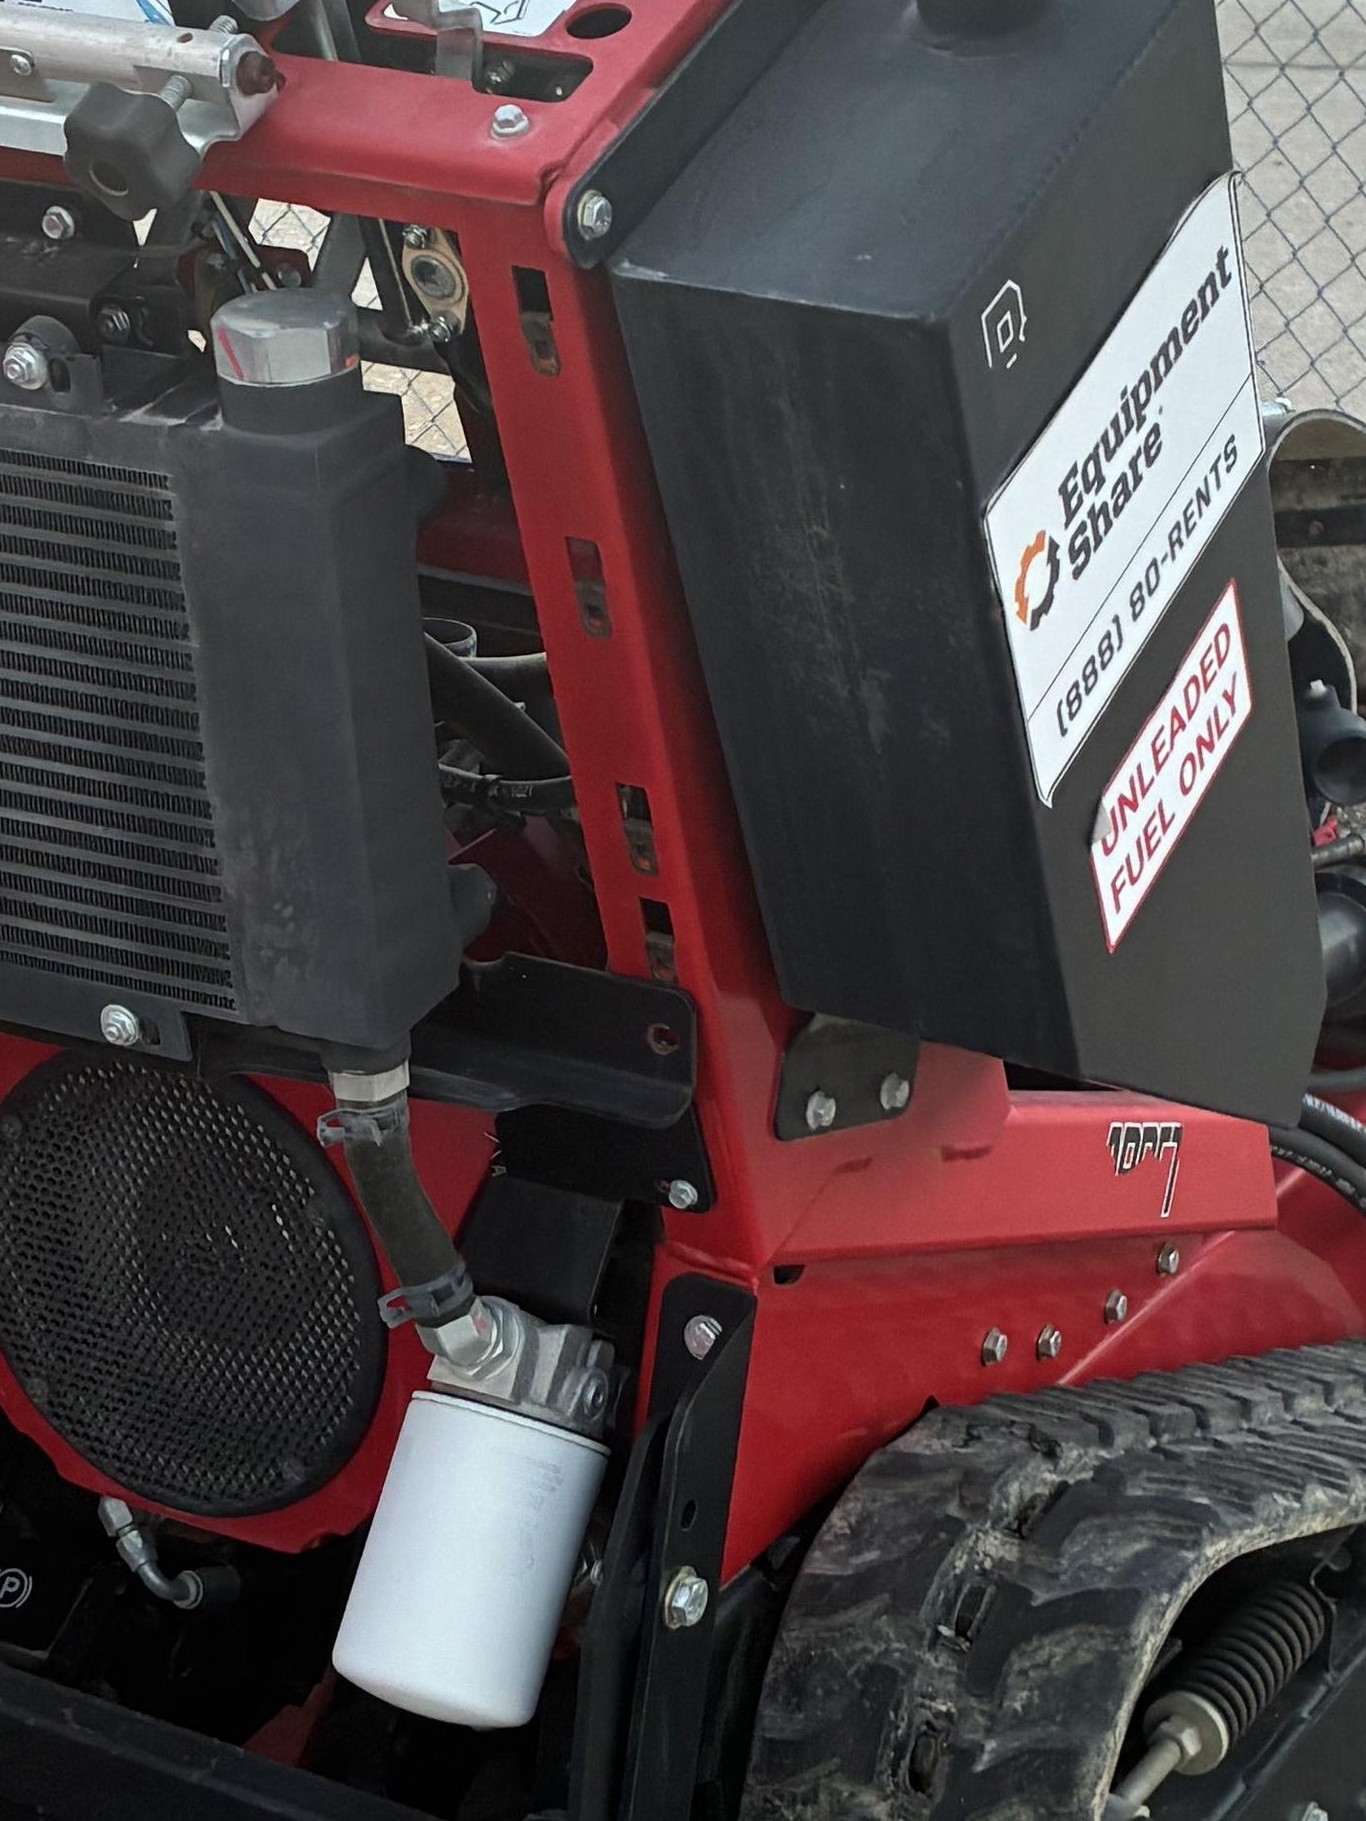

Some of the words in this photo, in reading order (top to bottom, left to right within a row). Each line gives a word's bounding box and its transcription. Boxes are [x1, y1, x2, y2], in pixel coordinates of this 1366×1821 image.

[1058, 245, 1232, 530] Equipment
[1068, 422, 1163, 581] Share
[1056, 613, 1124, 738] (888)
[1129, 434, 1238, 623] 80-RENTS
[1101, 623, 1231, 857] UNLEADED
[1110, 798, 1176, 915] FUEL
[1179, 671, 1238, 797] ONLY
